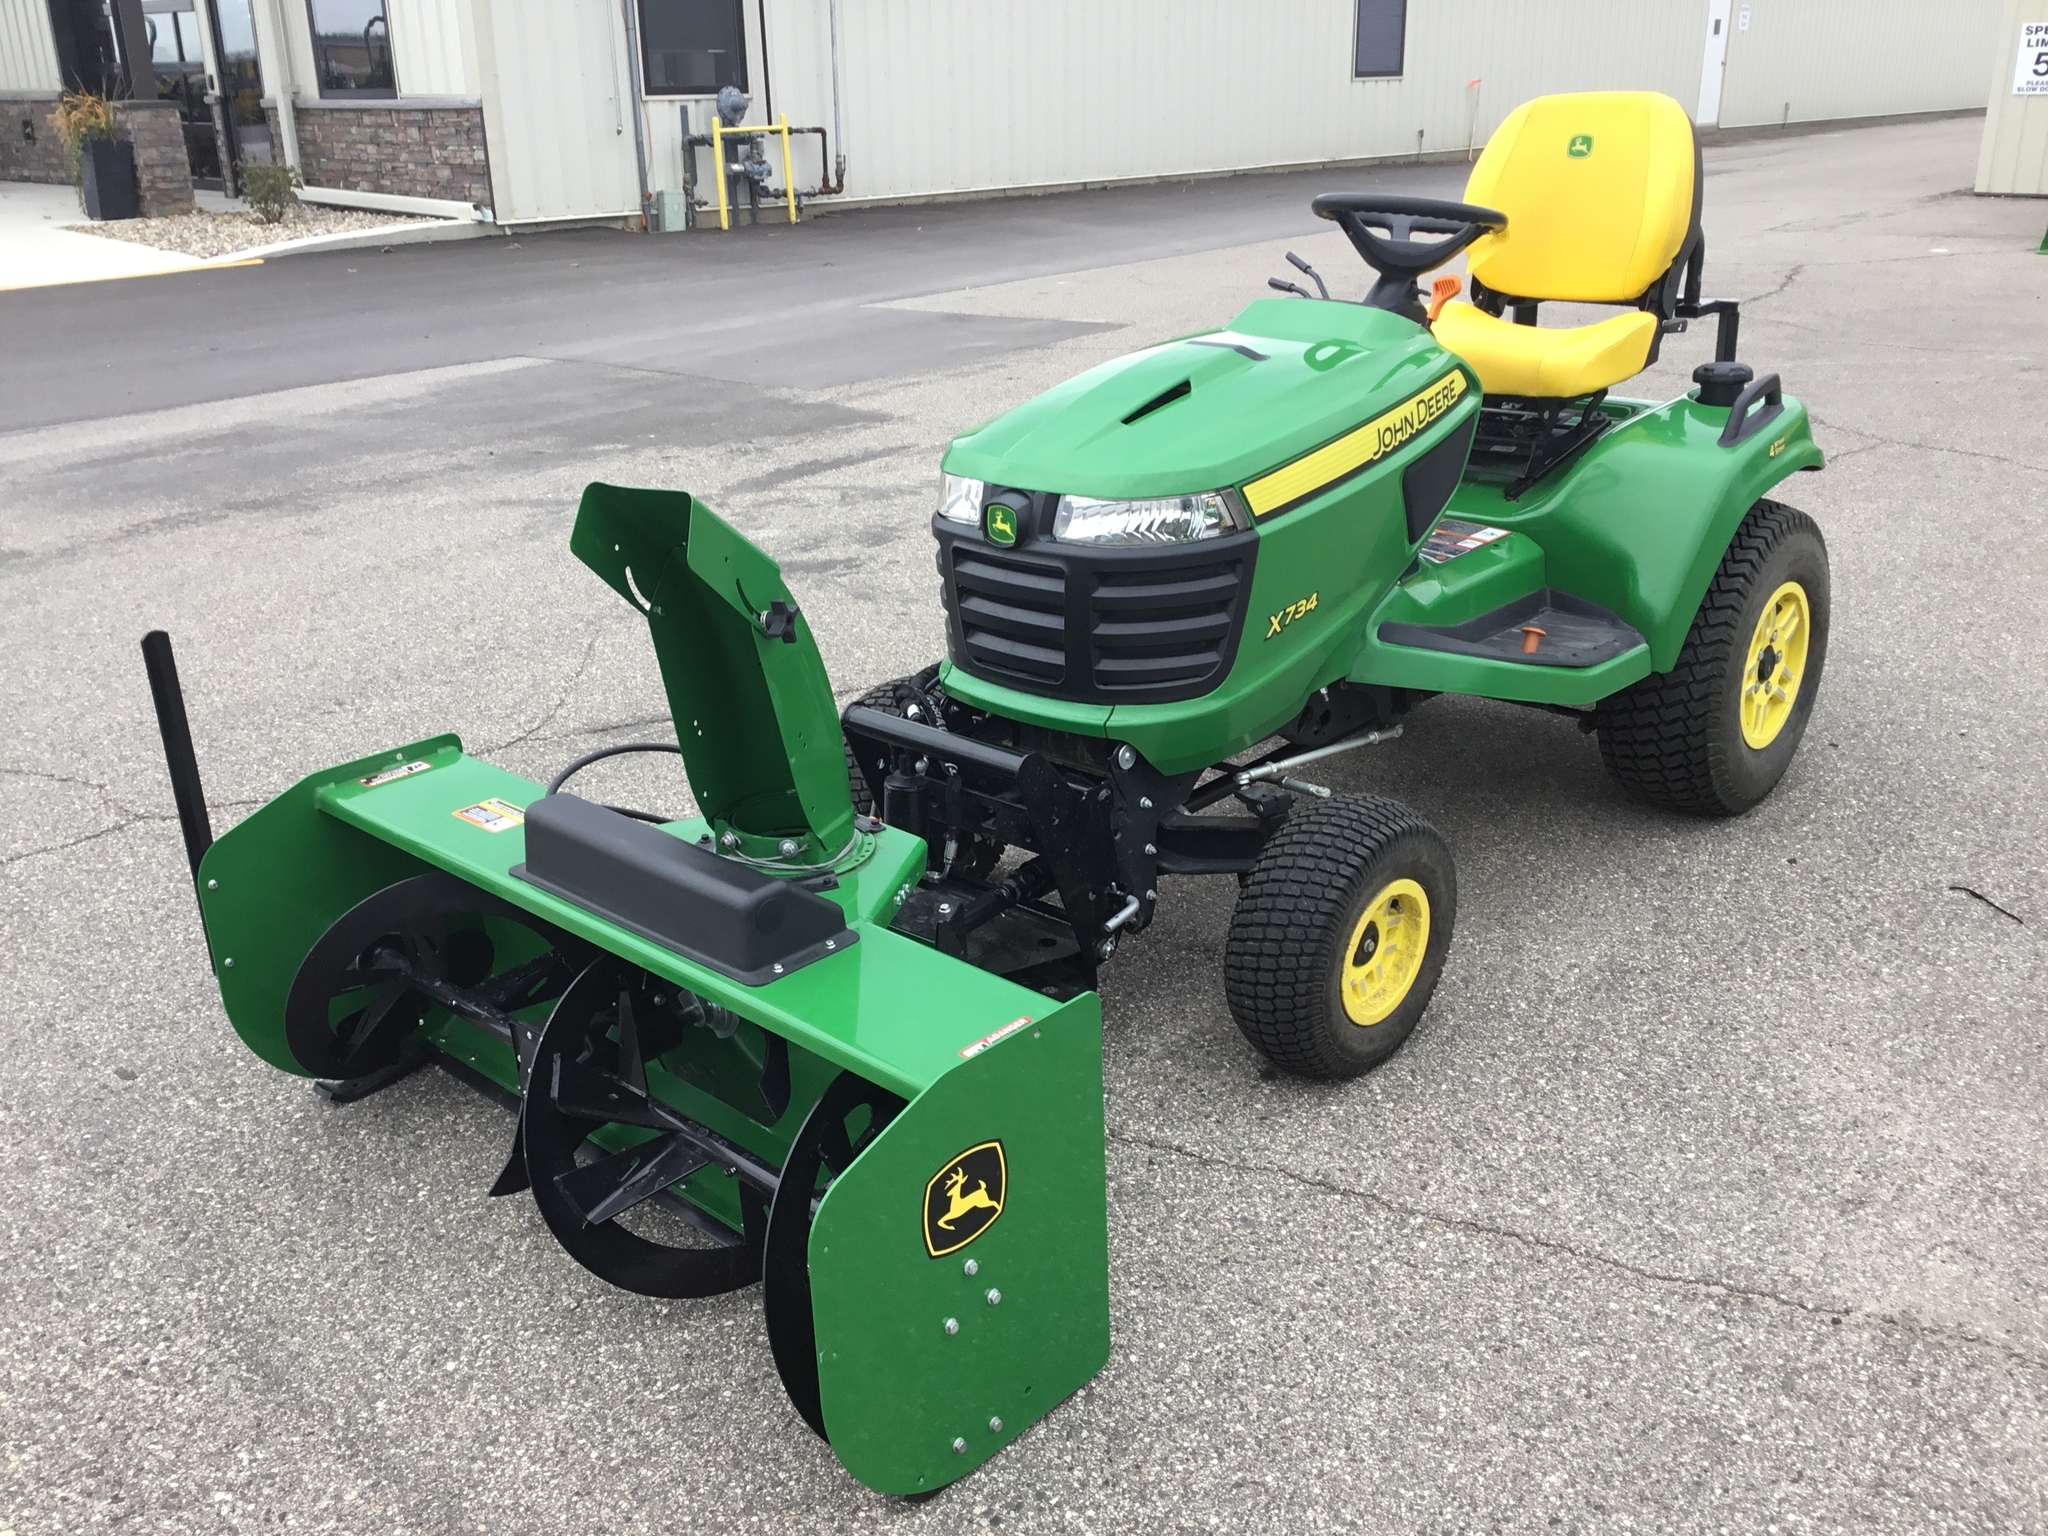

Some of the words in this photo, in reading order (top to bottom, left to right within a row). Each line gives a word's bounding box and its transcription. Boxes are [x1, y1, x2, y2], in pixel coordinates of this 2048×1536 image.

[1373, 410, 1415, 457] JOHN
[1416, 379, 1458, 427] DEERE
[1264, 591, 1319, 641] X734
